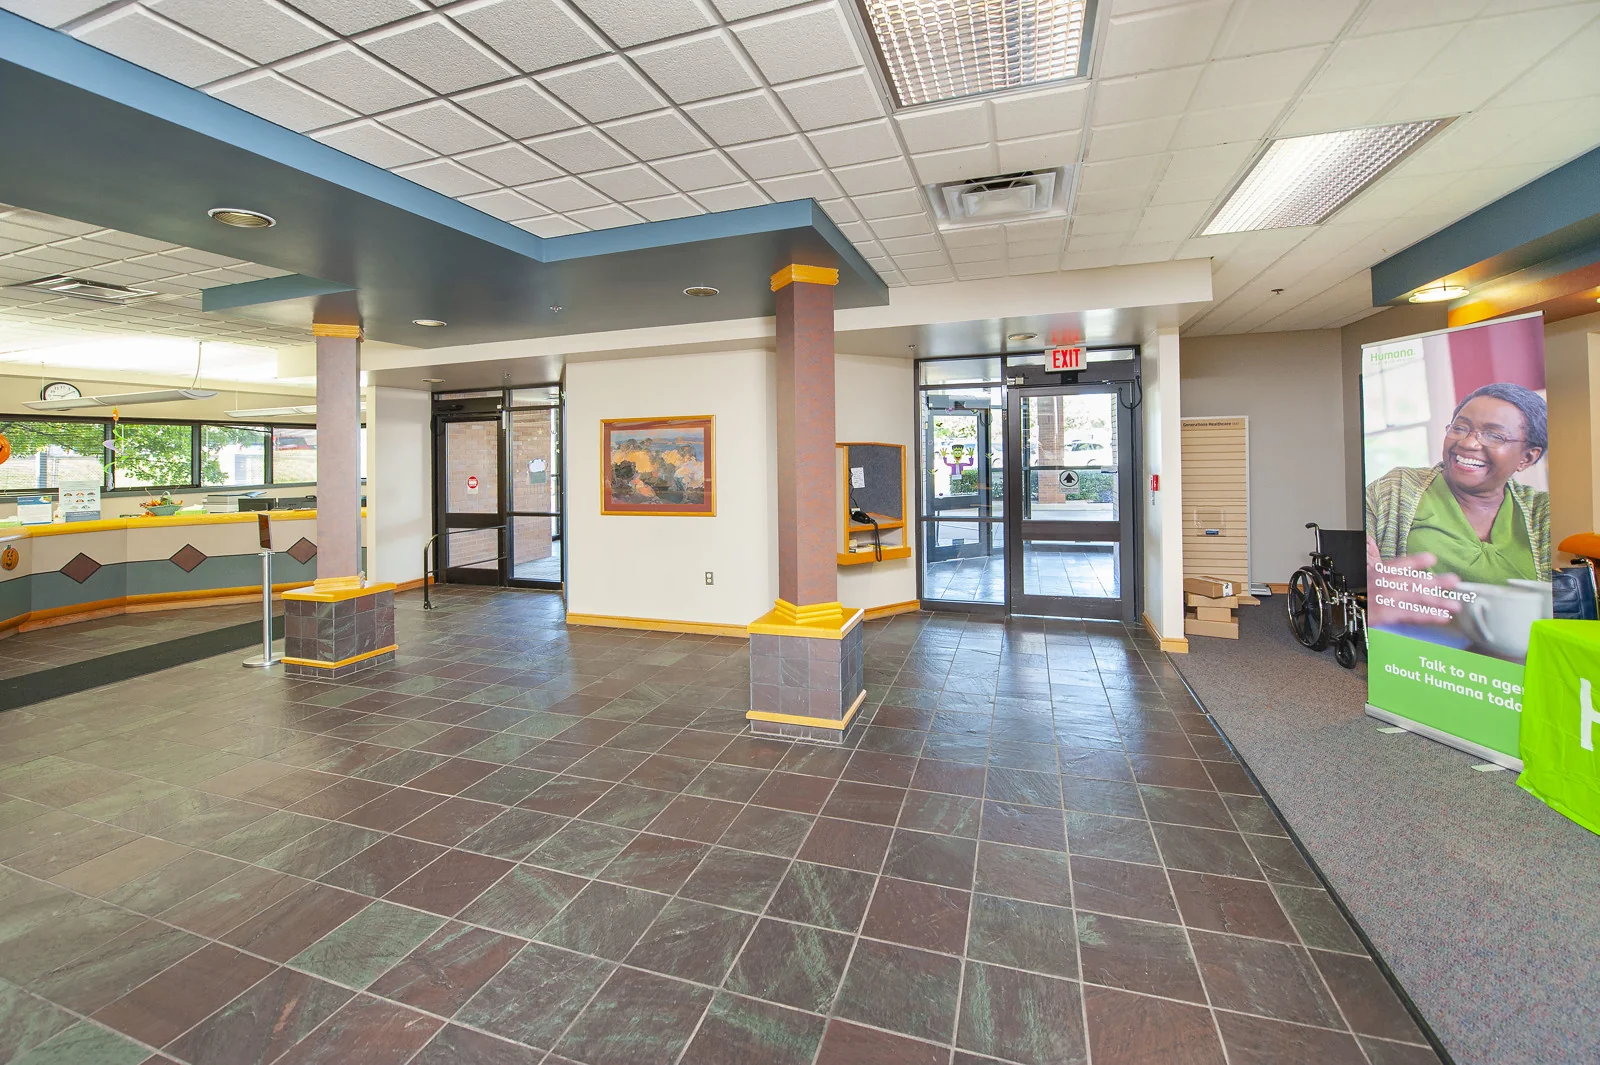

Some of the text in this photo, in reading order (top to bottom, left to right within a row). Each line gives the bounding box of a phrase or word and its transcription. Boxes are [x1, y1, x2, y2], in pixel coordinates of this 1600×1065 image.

[1052, 348, 1081, 368] EXIT
[1374, 562, 1433, 580] Questions
[1375, 577, 1477, 604] about Medicare?
[1375, 594, 1453, 620] Get answers.
[1384, 663, 1421, 682] about
[1424, 673, 1484, 700] Humana
[1418, 655, 1447, 674] Talk
[1450, 664, 1465, 679] to
[1469, 672, 1488, 686] an
